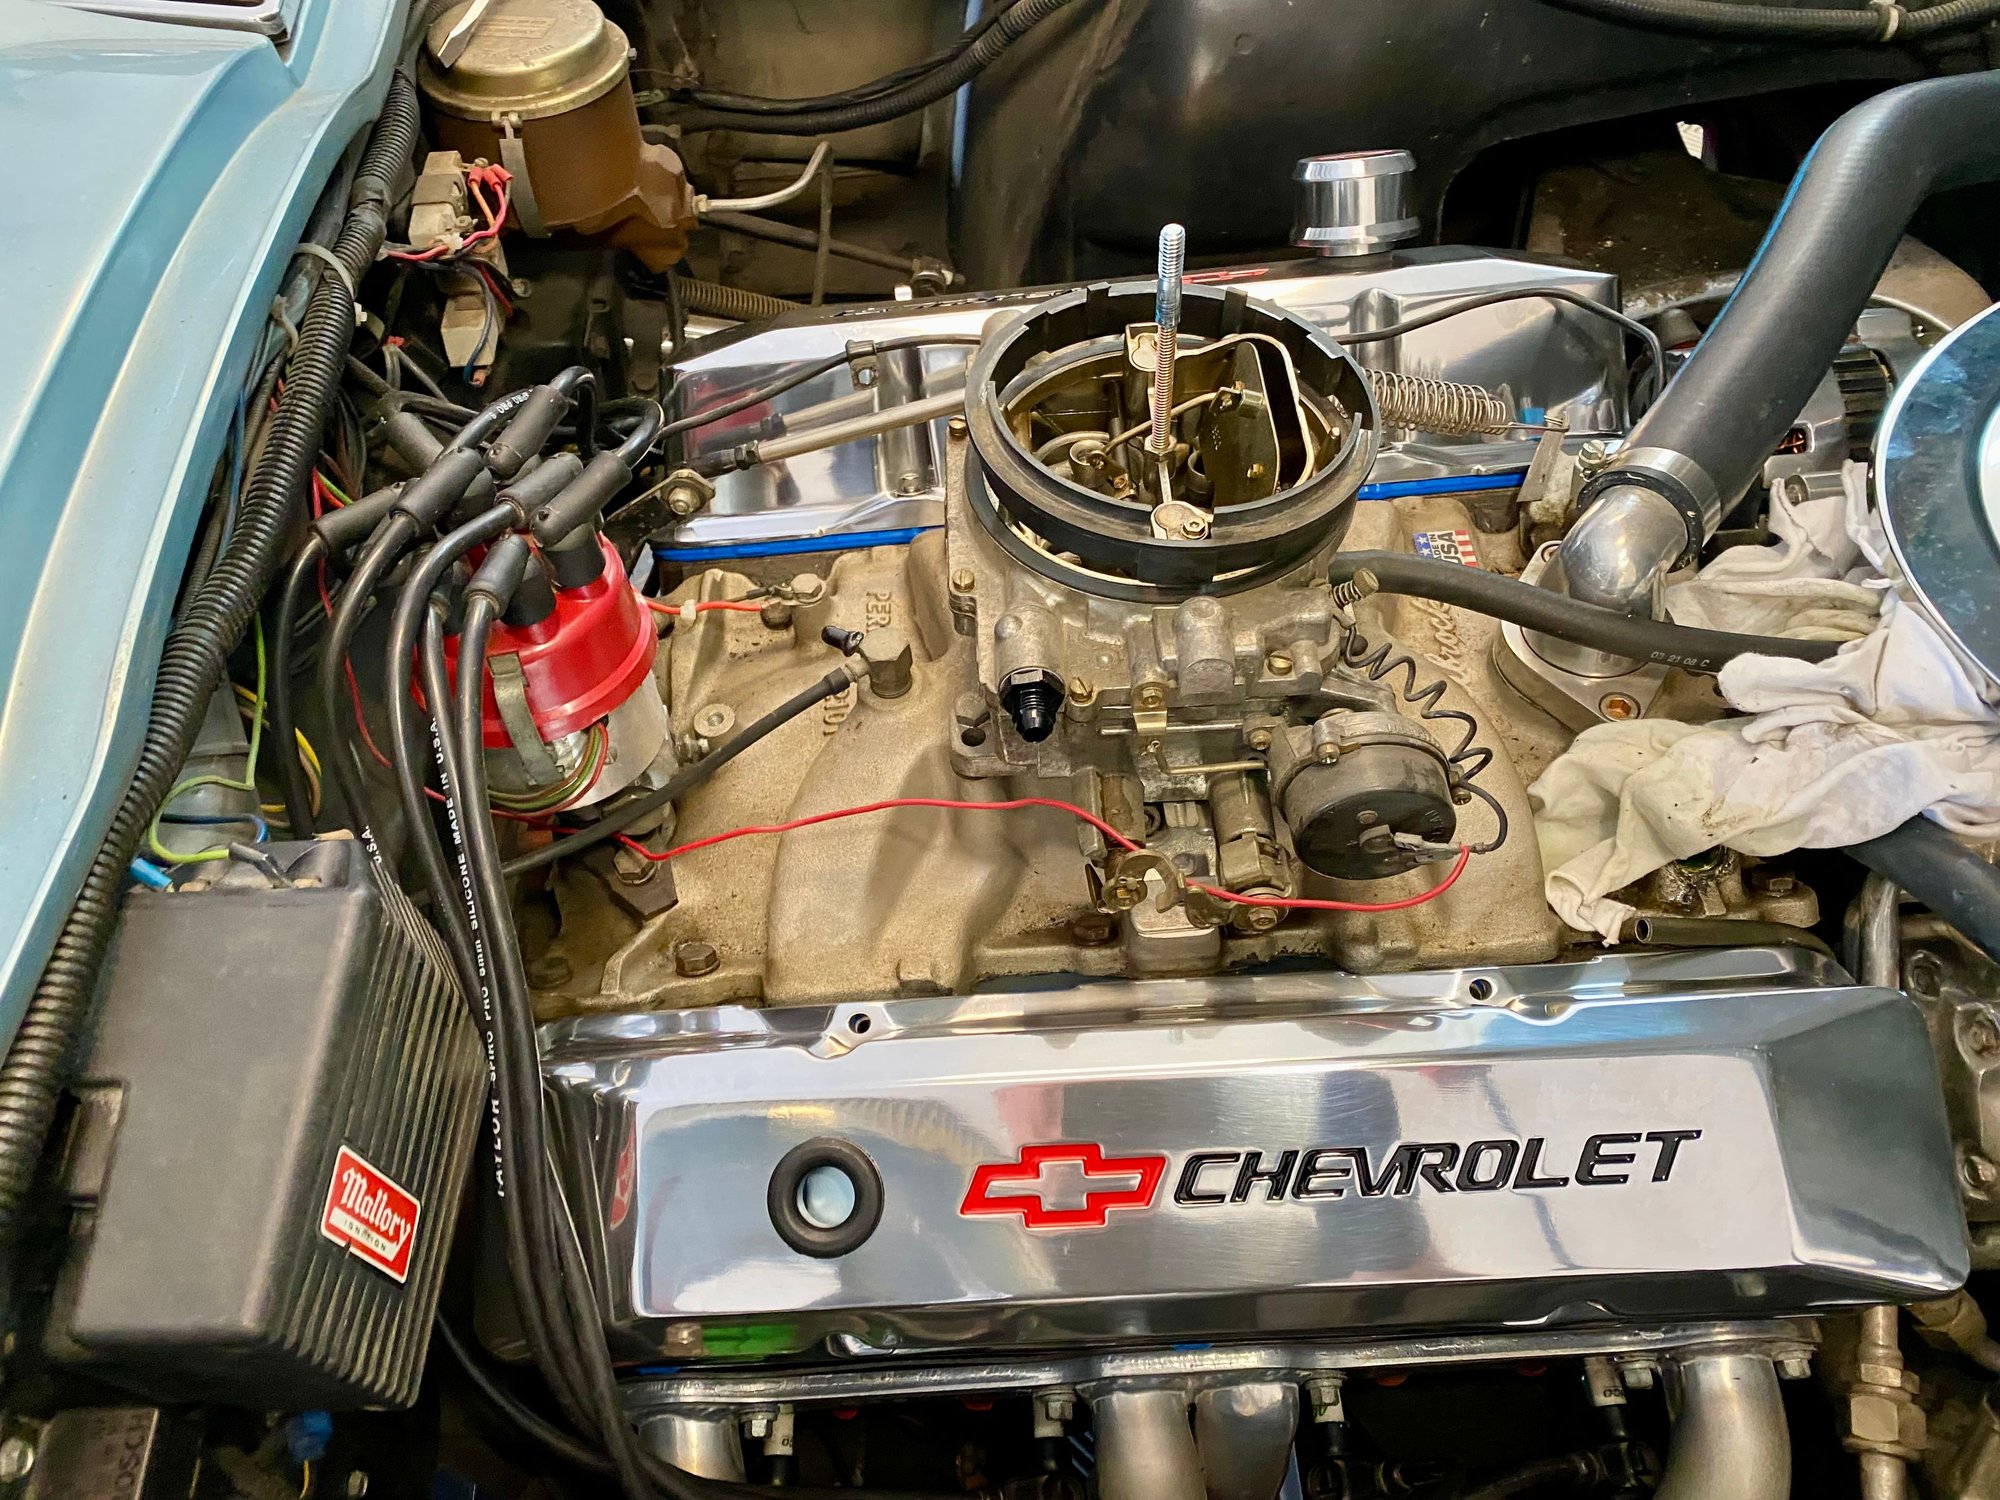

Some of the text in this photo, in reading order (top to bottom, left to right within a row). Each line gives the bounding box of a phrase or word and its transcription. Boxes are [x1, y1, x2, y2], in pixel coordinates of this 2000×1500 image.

[866, 591, 892, 633] PER
[430, 717, 444, 764] U.S.A.
[440, 772, 450, 790] IN
[446, 797, 462, 845] MADE
[457, 853, 479, 931] SILICONE
[1174, 1129, 1702, 1206] CHEVROLET
[341, 1167, 411, 1246] Mallory
